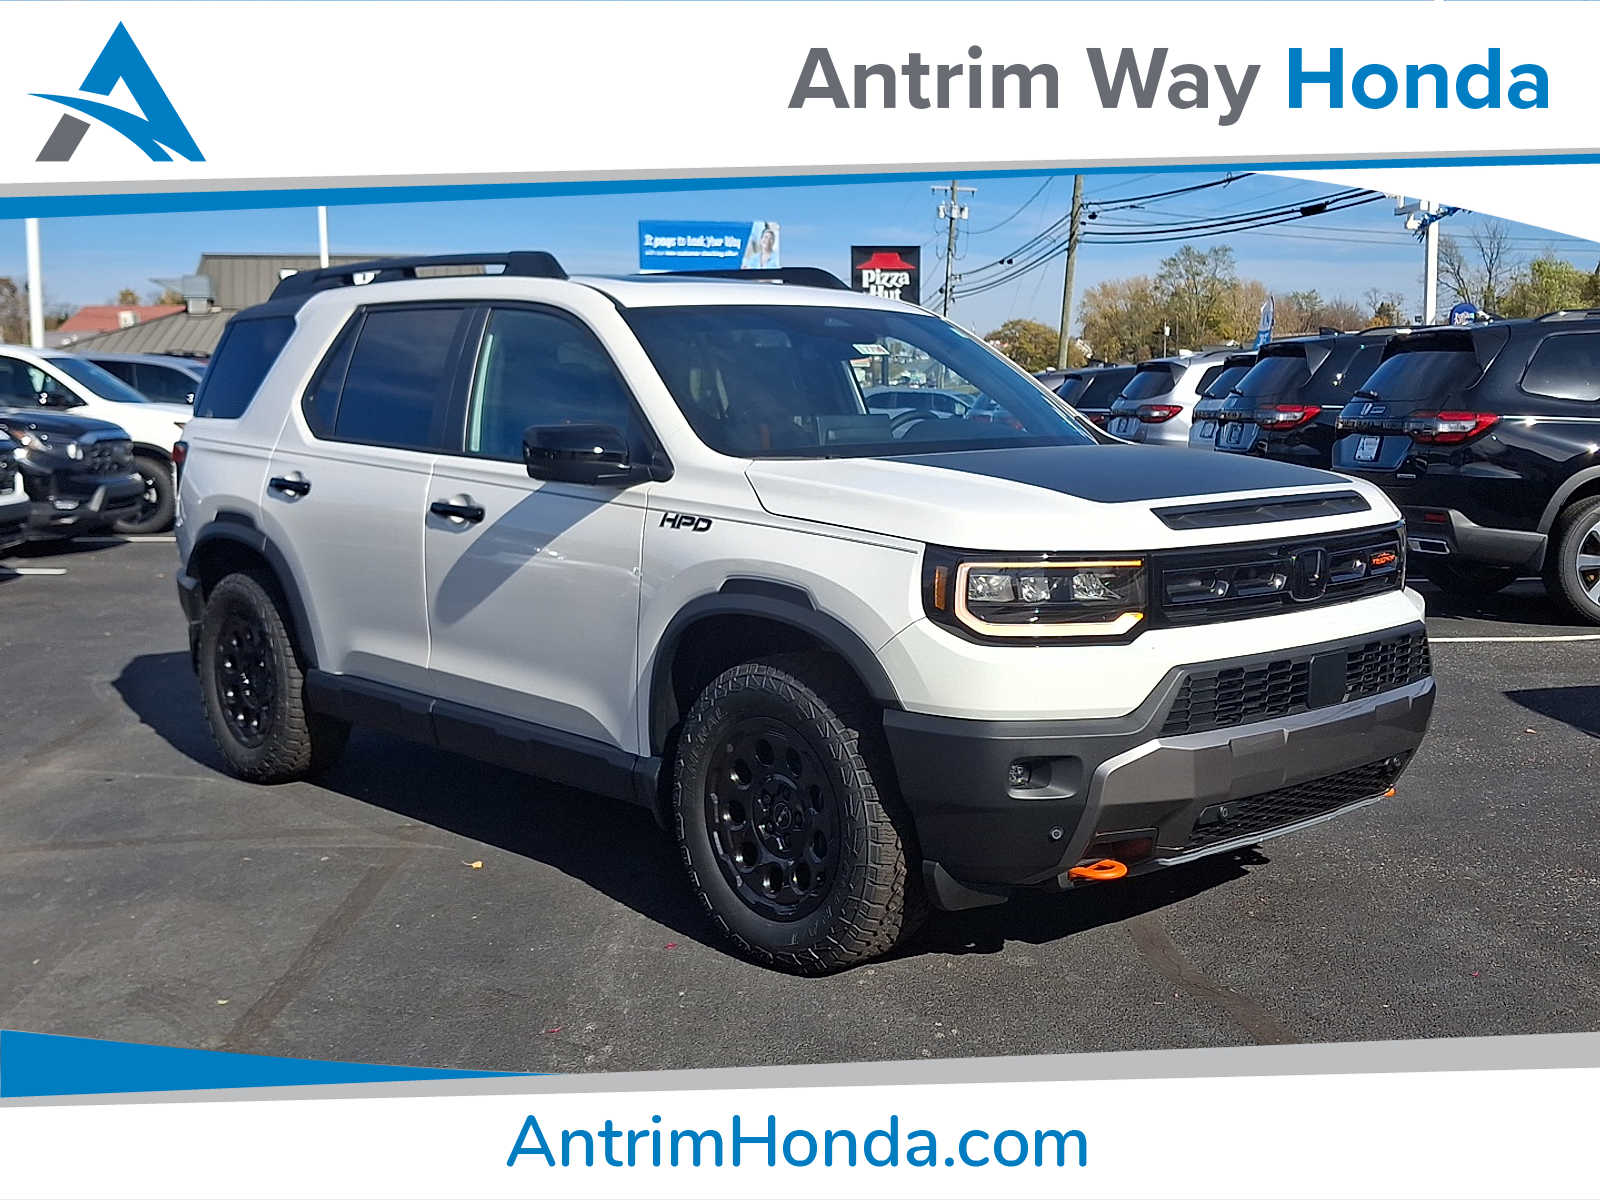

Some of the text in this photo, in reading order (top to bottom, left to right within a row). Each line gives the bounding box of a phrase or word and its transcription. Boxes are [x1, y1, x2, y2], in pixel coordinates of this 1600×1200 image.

[862, 268, 911, 288] Pizza
[869, 284, 902, 301] Hut
[659, 511, 713, 532] HPD
